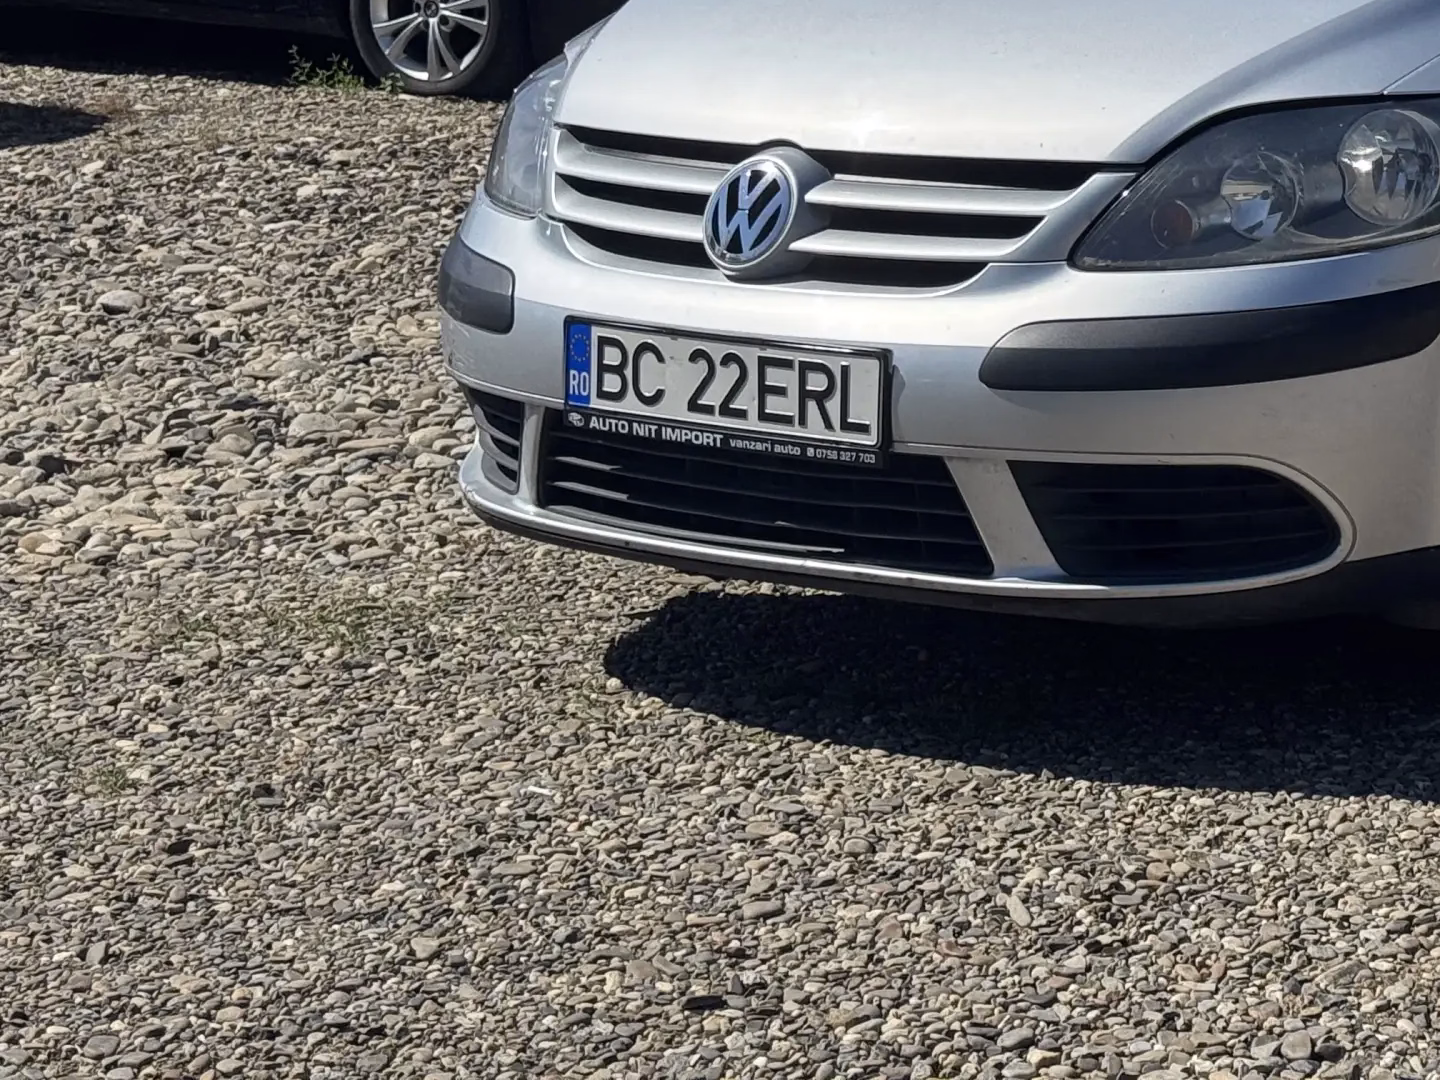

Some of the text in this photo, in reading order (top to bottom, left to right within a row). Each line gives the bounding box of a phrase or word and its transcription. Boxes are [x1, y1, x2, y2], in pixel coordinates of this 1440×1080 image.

[569, 369, 590, 396] RO
[597, 334, 872, 434] BC 22ERL
[589, 416, 629, 434] AUTO
[632, 422, 658, 438] NIT
[662, 426, 723, 447] IMPORT
[729, 438, 772, 452] vanzari
[774, 443, 801, 456] auto
[840, 451, 856, 461] 327
[858, 453, 876, 464] 703
